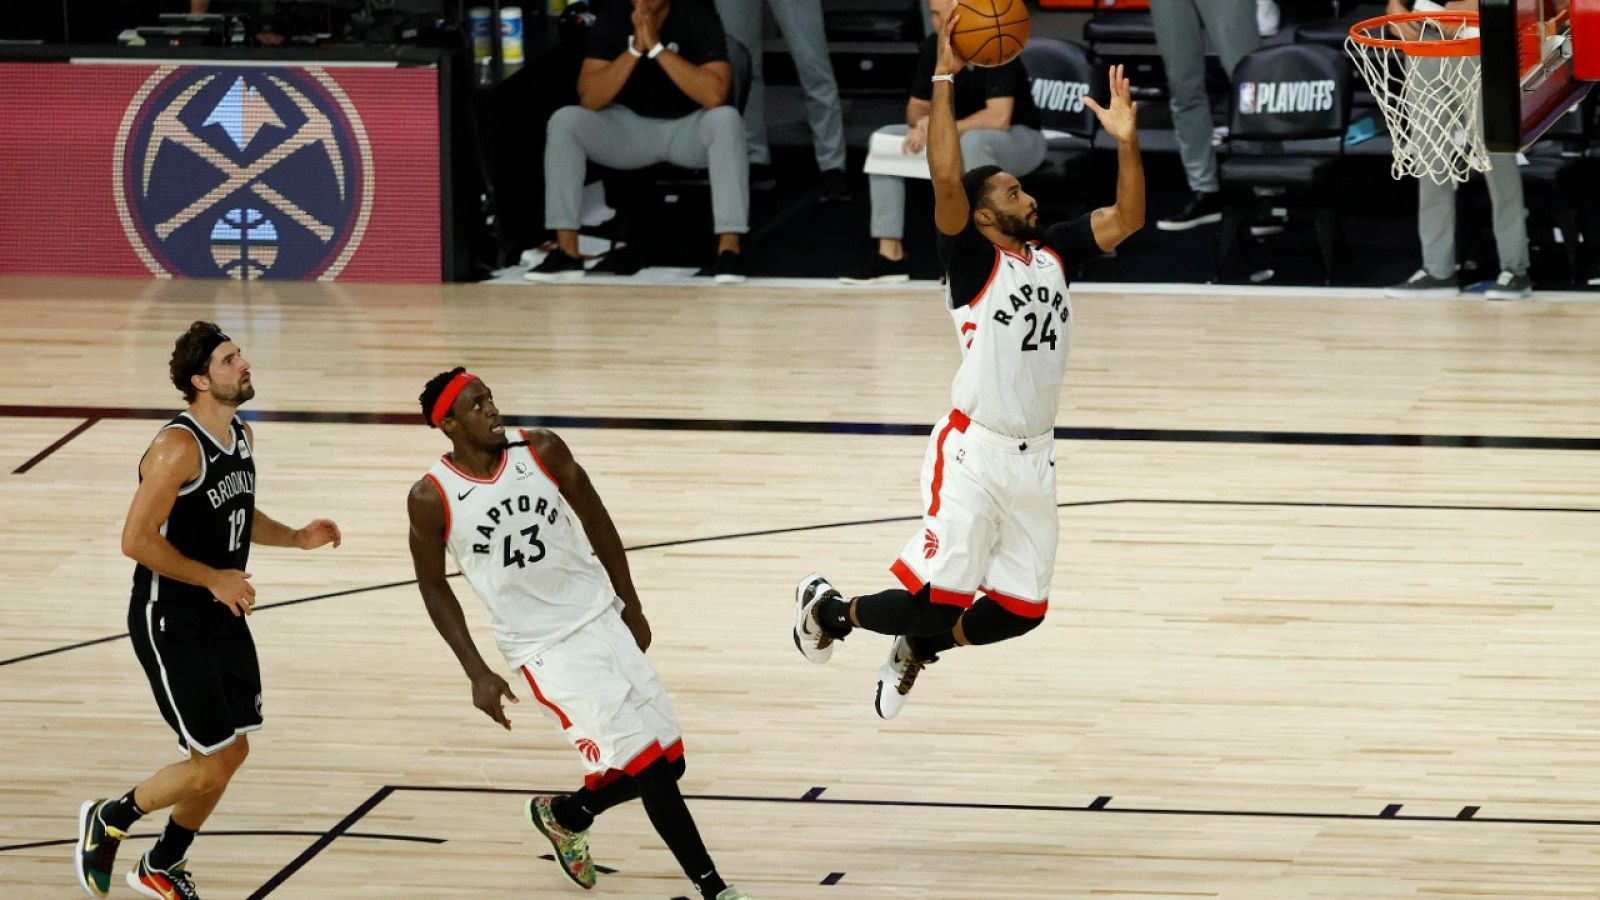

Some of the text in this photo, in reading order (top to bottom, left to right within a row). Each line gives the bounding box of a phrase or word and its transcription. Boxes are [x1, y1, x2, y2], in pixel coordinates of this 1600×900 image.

[1255, 79, 1336, 114] PLAYOFFS
[1021, 312, 1057, 351] 24
[206, 470, 255, 509] BROOKLY
[228, 508, 246, 552] 12
[473, 495, 558, 555] RAPTORS
[503, 524, 546, 569] 43
